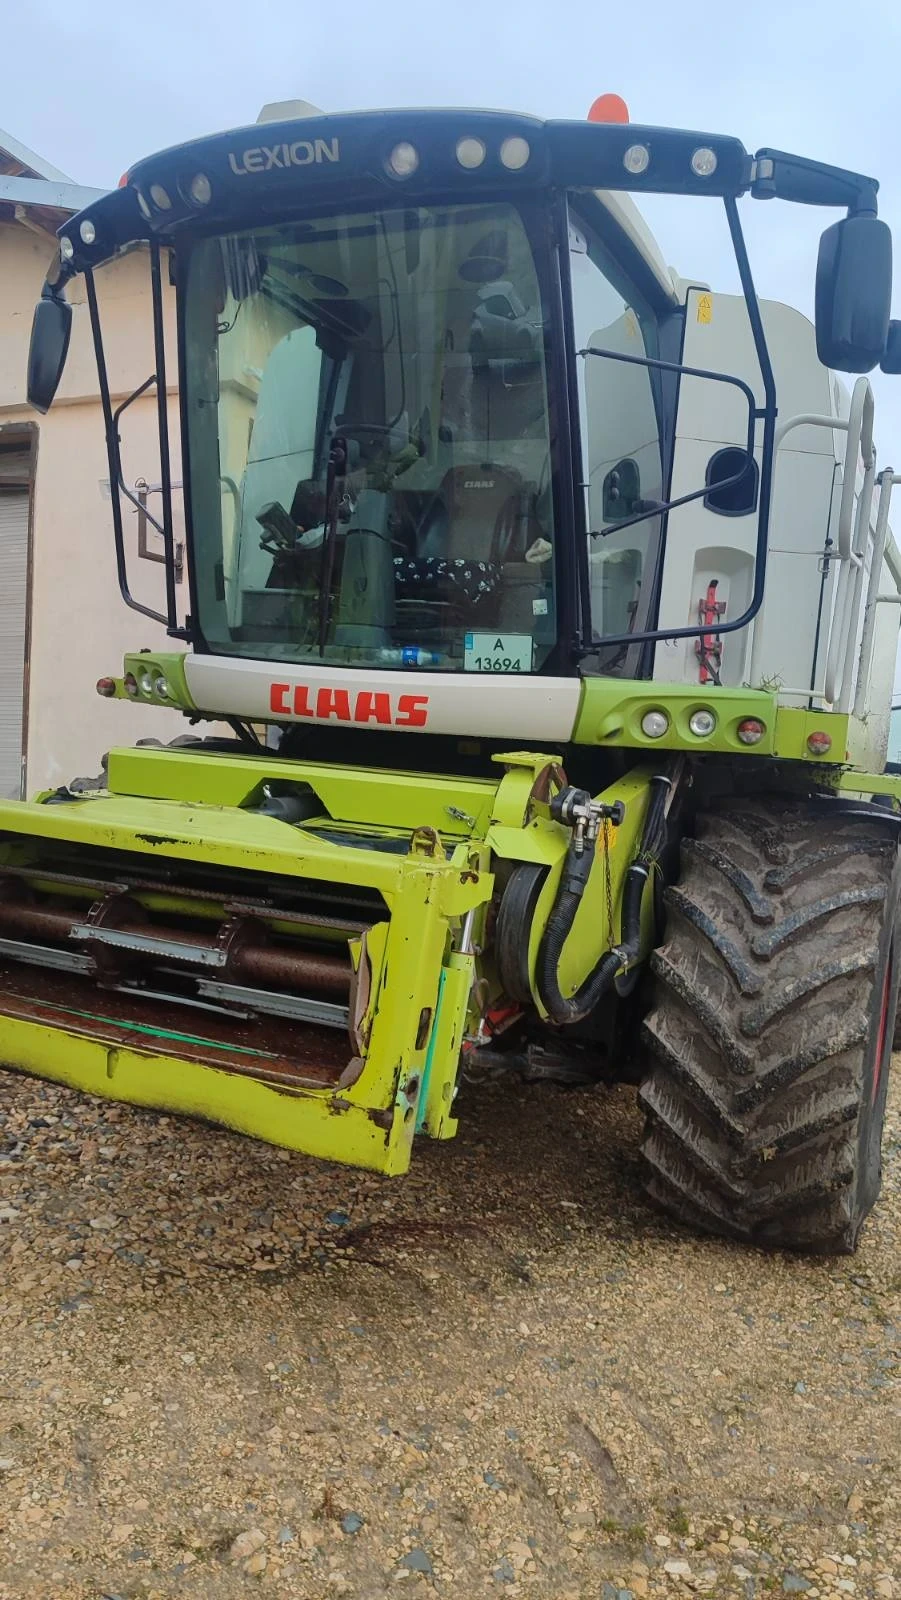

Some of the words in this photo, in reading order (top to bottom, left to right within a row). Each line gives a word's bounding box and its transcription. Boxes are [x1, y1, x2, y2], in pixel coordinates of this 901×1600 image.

[228, 137, 340, 175] LEXION
[493, 638, 504, 651] A
[475, 657, 521, 671] 13694
[270, 683, 429, 727] CLAAS
